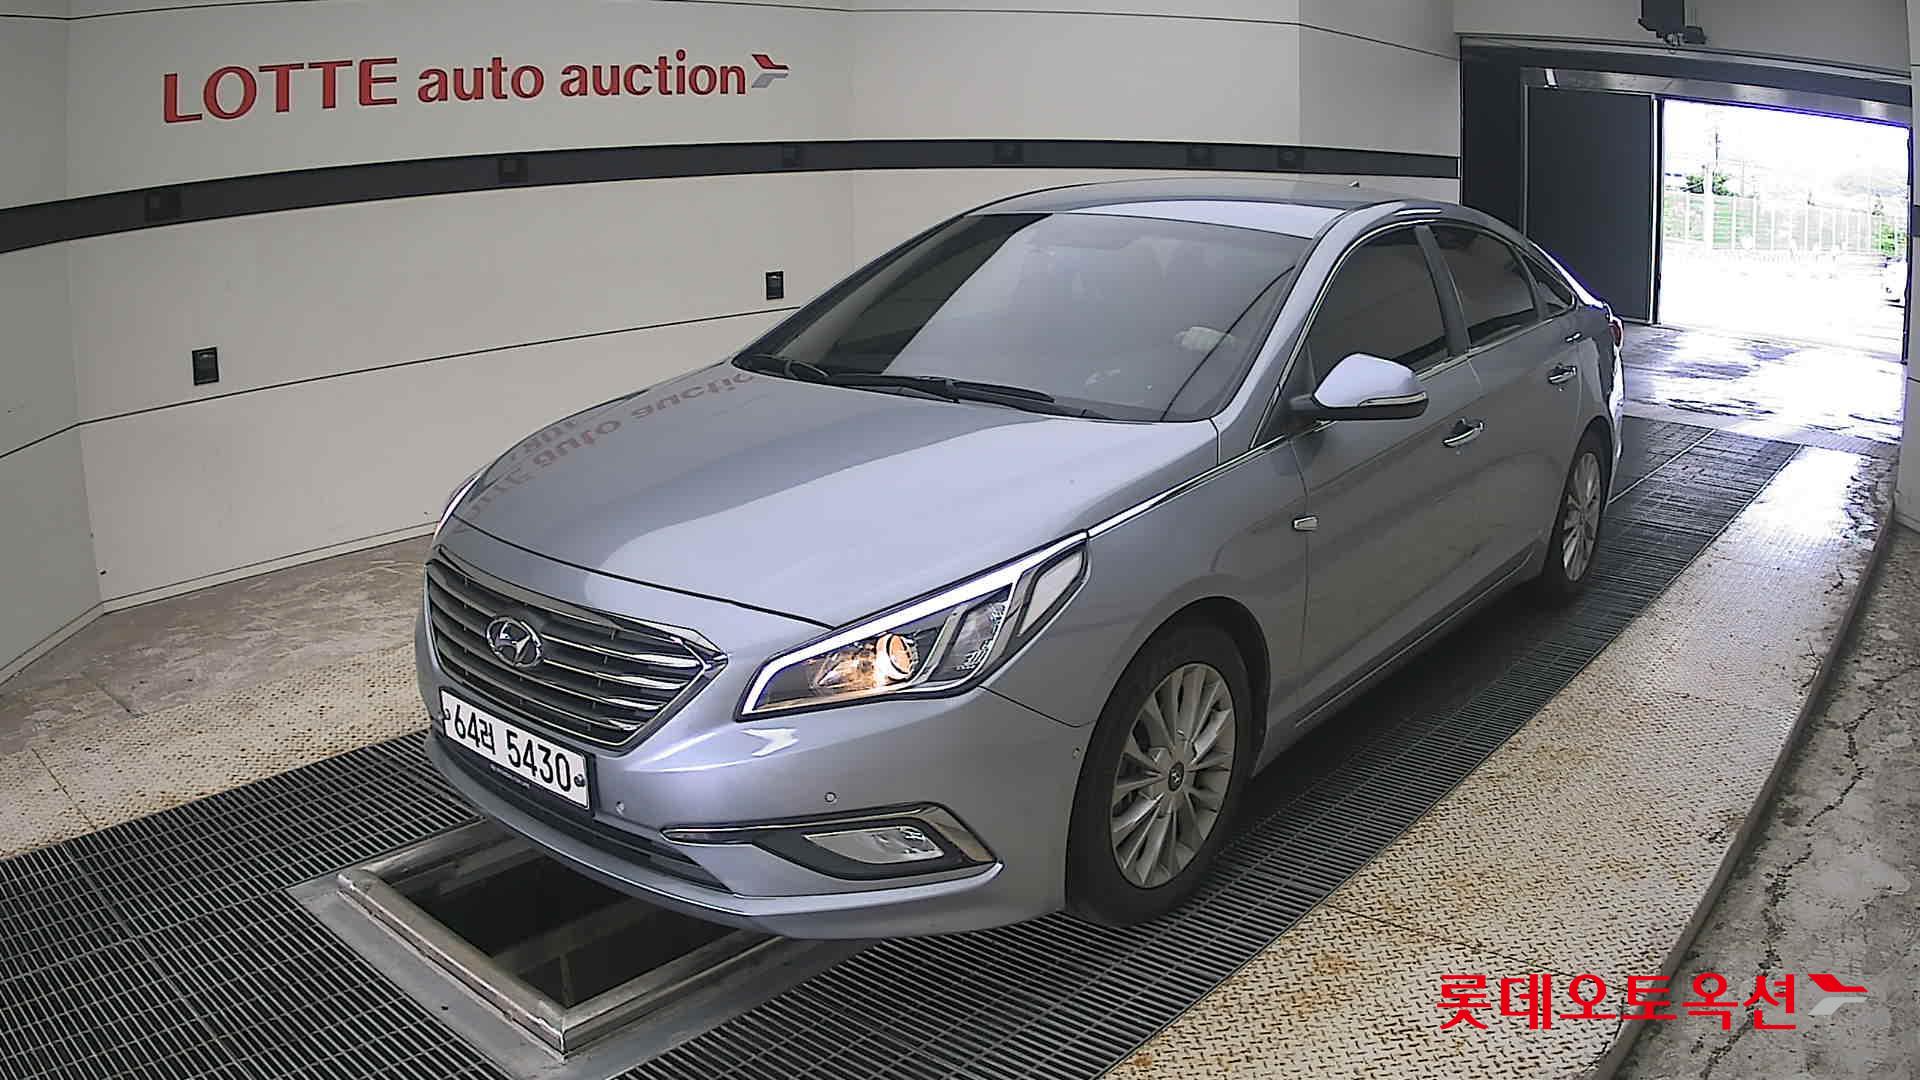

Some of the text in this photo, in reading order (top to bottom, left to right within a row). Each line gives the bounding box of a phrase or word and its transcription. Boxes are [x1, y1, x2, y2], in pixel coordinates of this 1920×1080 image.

[162, 48, 747, 124] LOTTE auto auction
[454, 704, 496, 755] 64러
[506, 729, 571, 792] 5430
